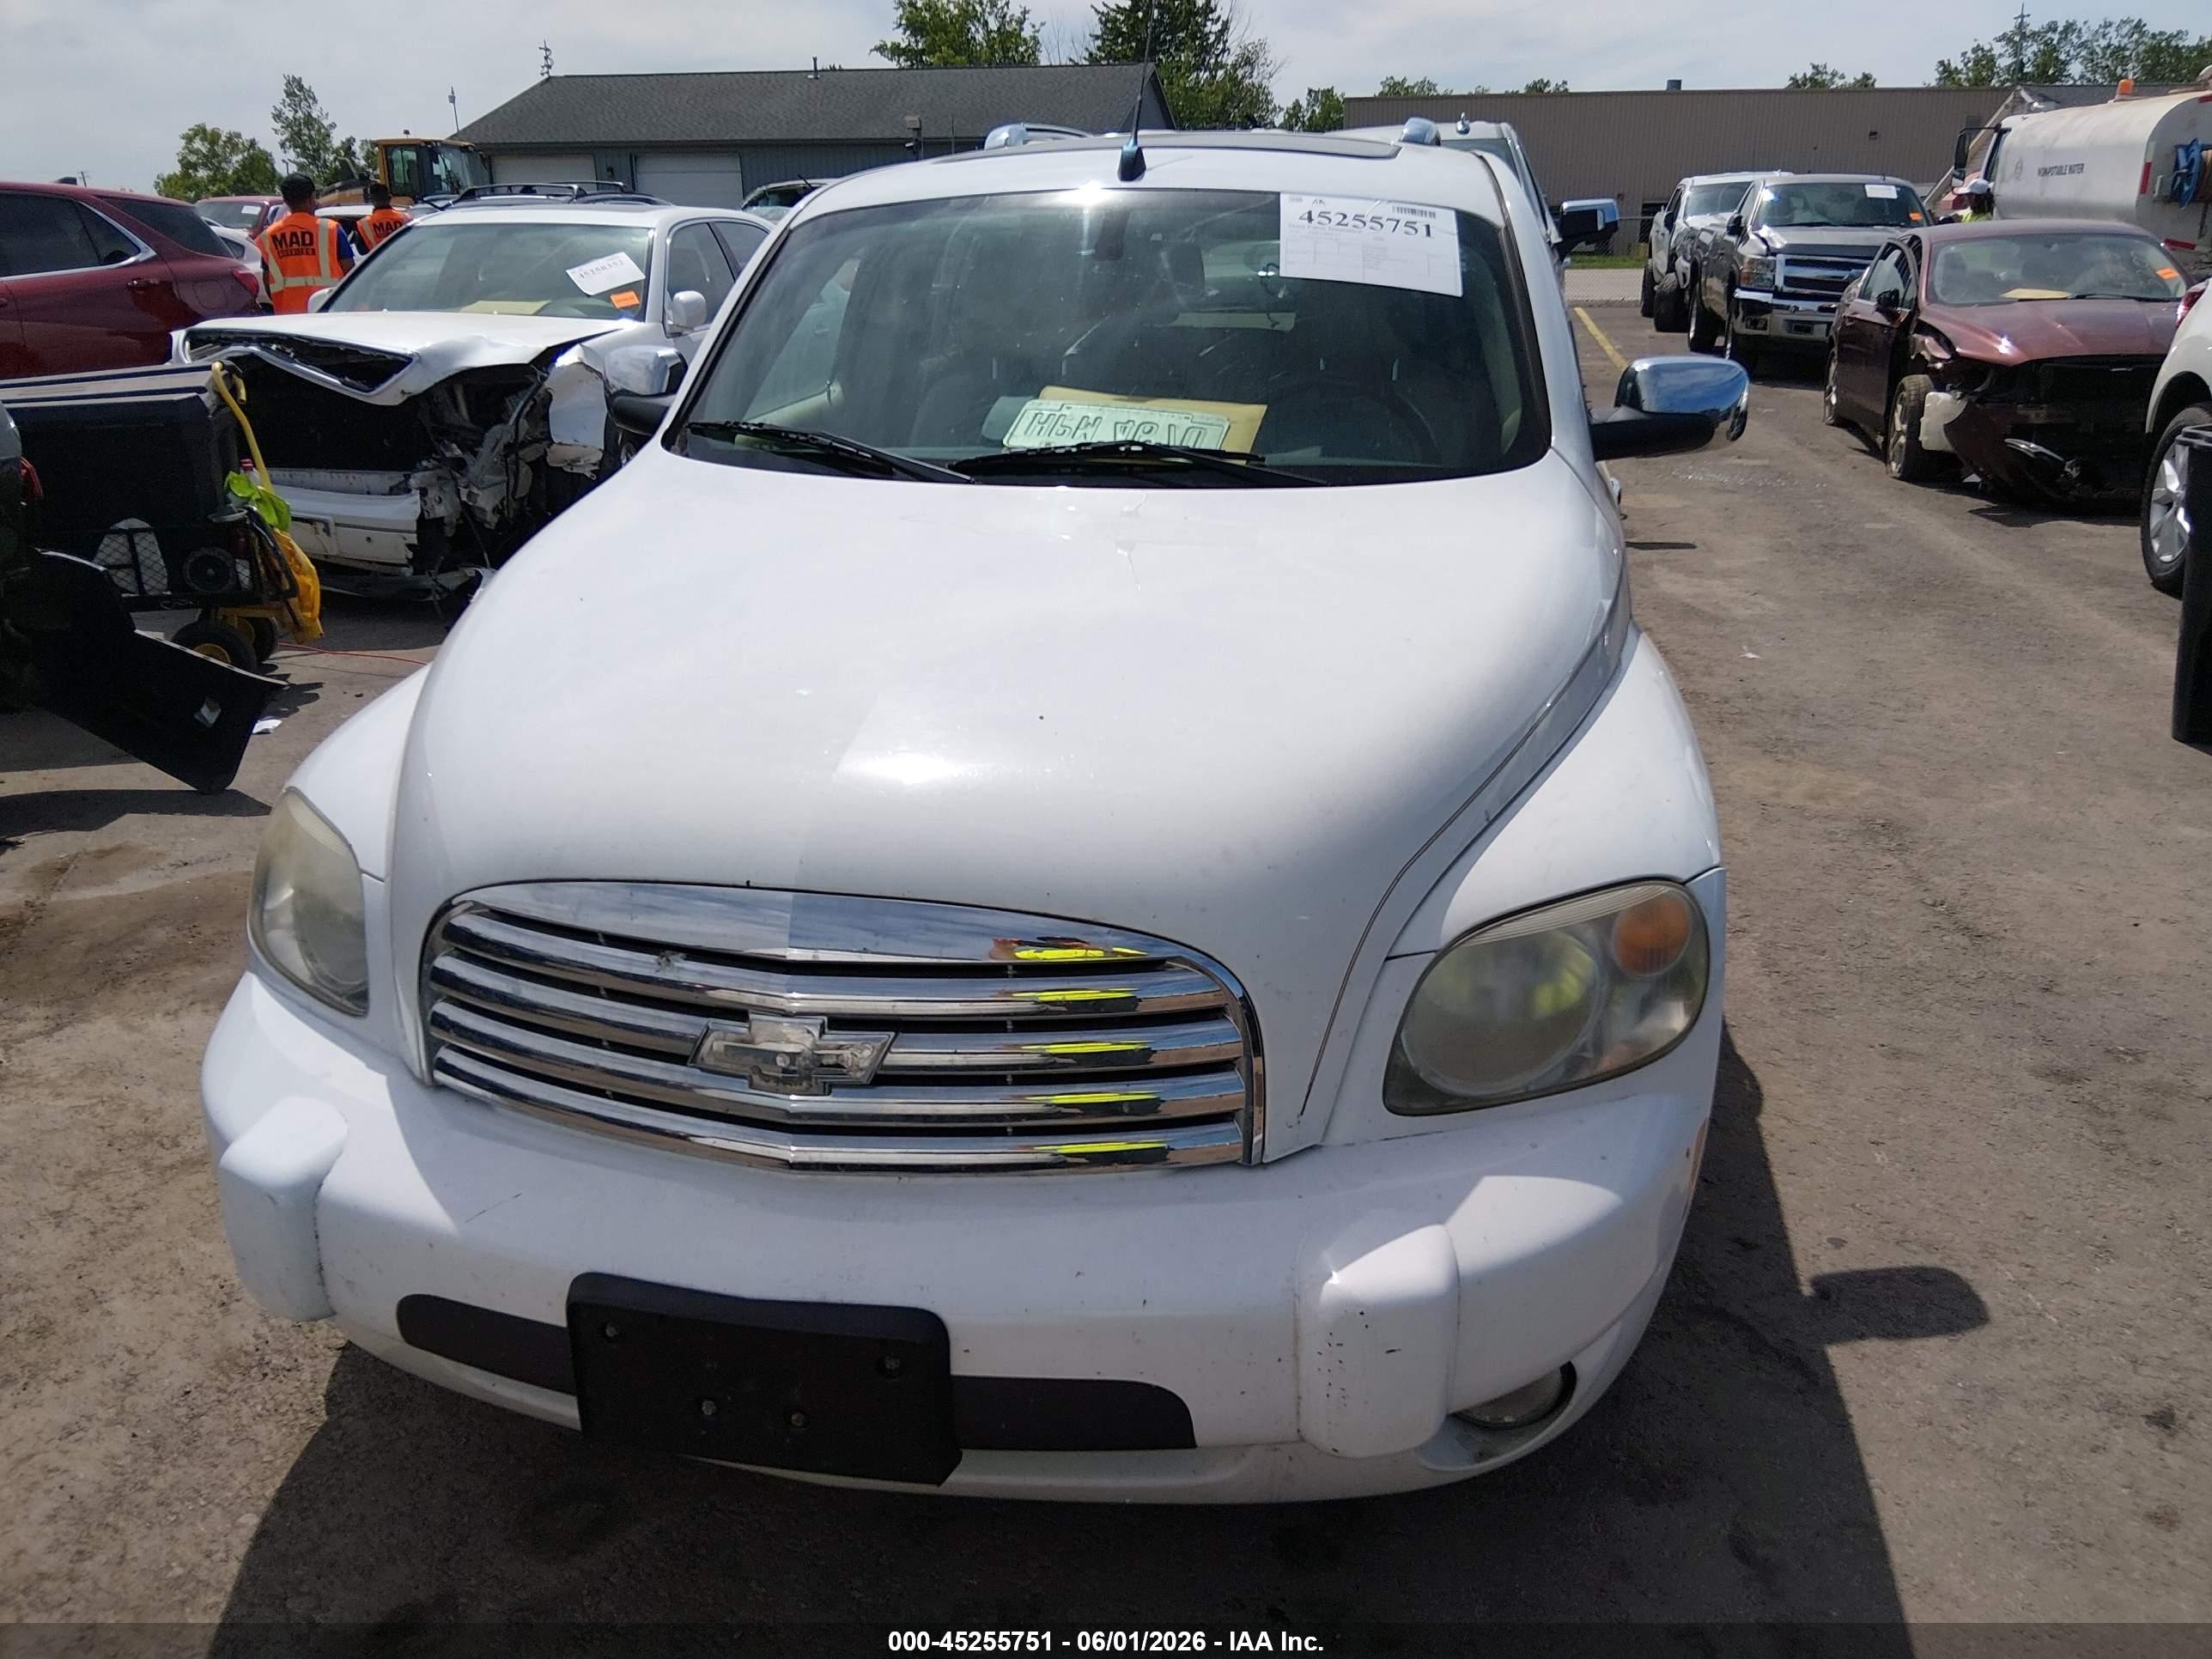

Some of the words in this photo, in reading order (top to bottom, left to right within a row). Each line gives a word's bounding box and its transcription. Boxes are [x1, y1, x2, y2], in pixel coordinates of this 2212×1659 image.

[373, 221, 403, 234] MAD
[1299, 210, 1431, 238] 45255751
[272, 231, 314, 251] MAD
